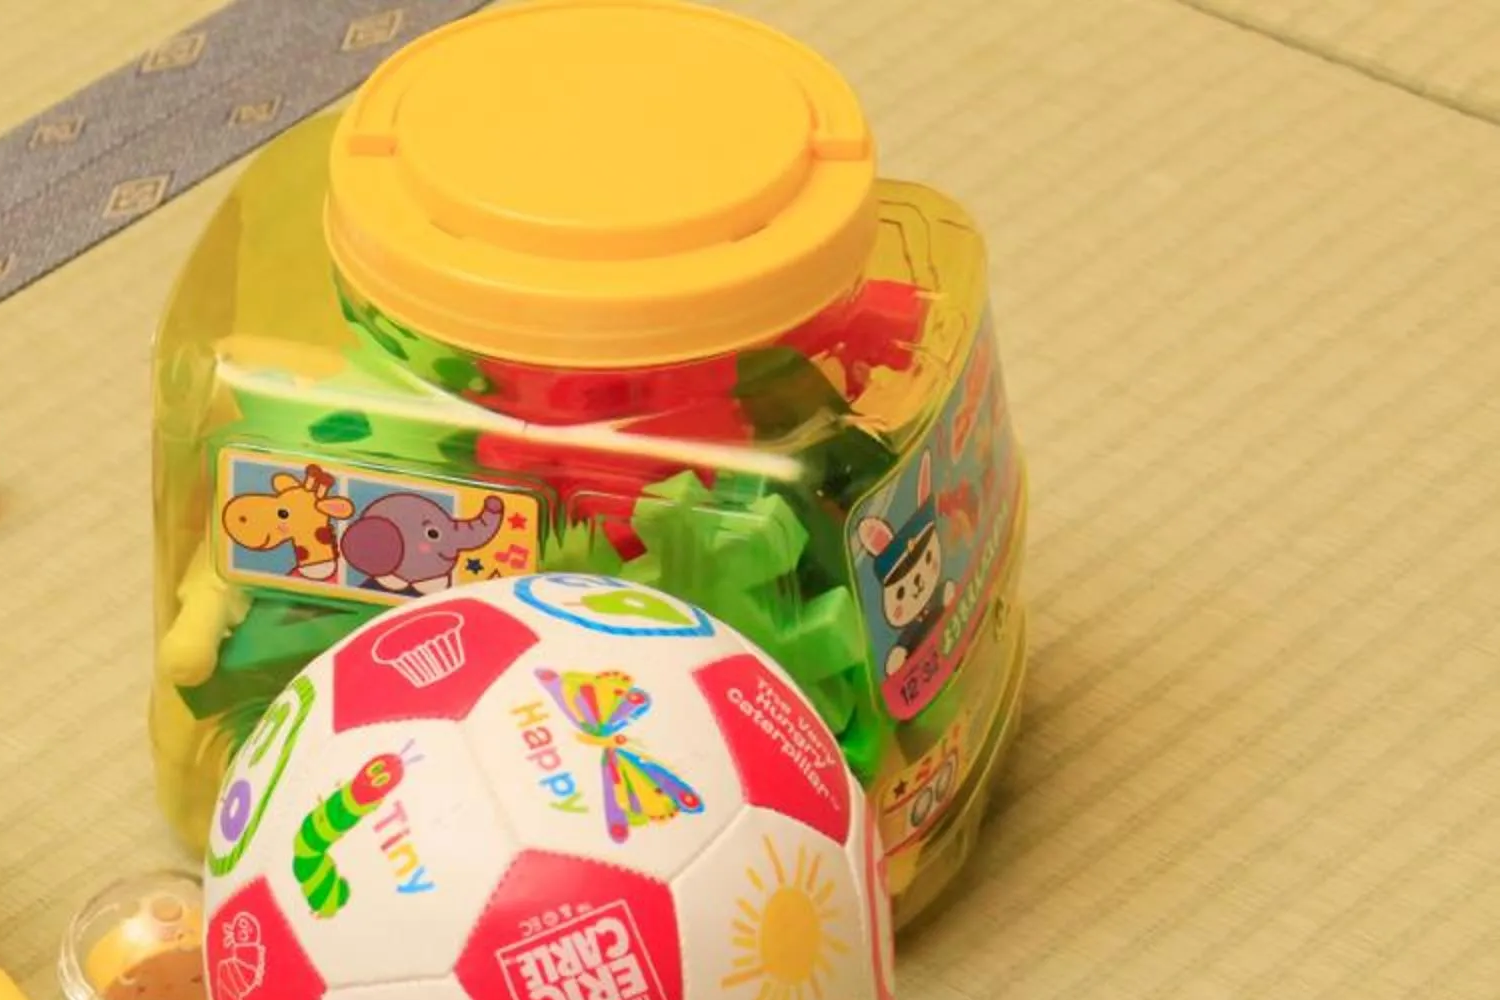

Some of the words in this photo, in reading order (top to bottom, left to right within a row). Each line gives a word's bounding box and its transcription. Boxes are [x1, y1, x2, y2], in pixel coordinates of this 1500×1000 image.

[509, 699, 589, 815] Happy
[755, 692, 827, 768] Hungry
[371, 801, 435, 896] Tiny
[515, 916, 632, 991] CARLE
